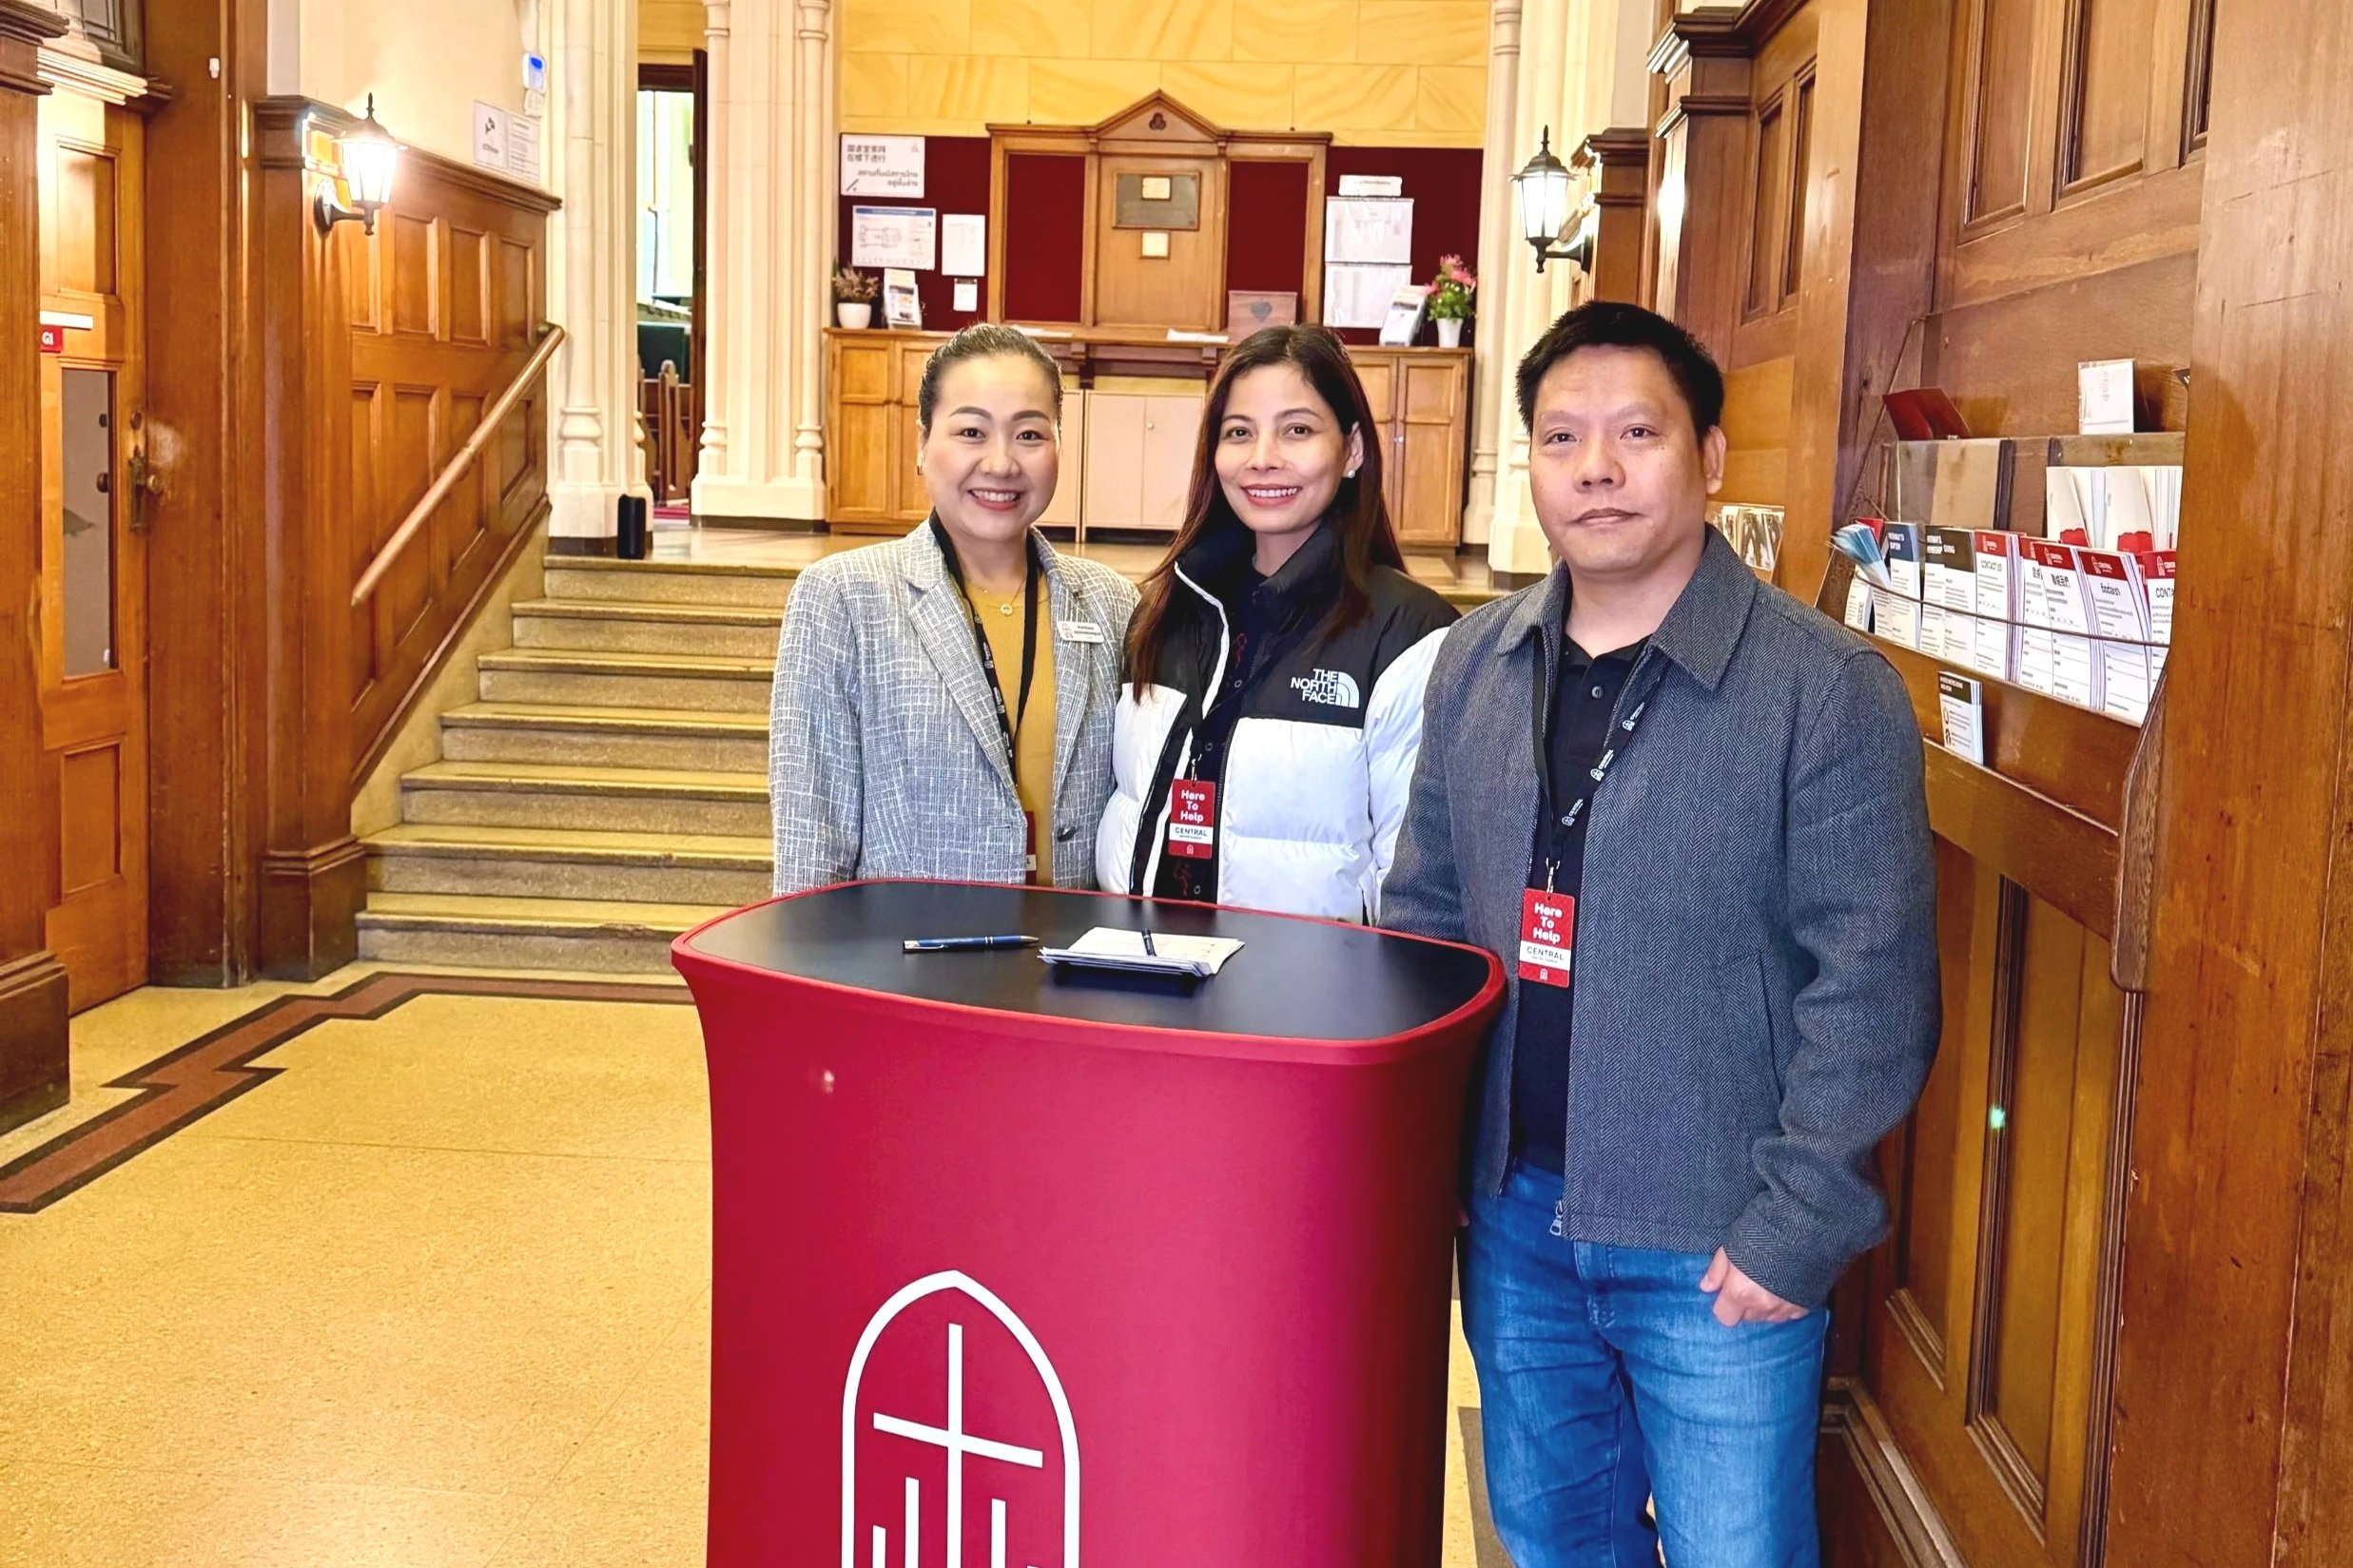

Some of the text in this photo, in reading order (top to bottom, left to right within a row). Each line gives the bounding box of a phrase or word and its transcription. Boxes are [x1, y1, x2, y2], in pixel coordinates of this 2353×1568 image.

[1313, 668, 1339, 683] THE
[1290, 676, 1337, 695] NORTH
[1301, 689, 1336, 705] FACE
[1180, 789, 1206, 802] Here
[1186, 801, 1198, 811] To
[1180, 810, 1204, 823] Help
[1175, 826, 1207, 837] CENTRAL
[1534, 902, 1563, 918] Here
[1540, 916, 1555, 929] To
[1532, 927, 1561, 944] Help
[1527, 946, 1565, 960] CENTRAL
